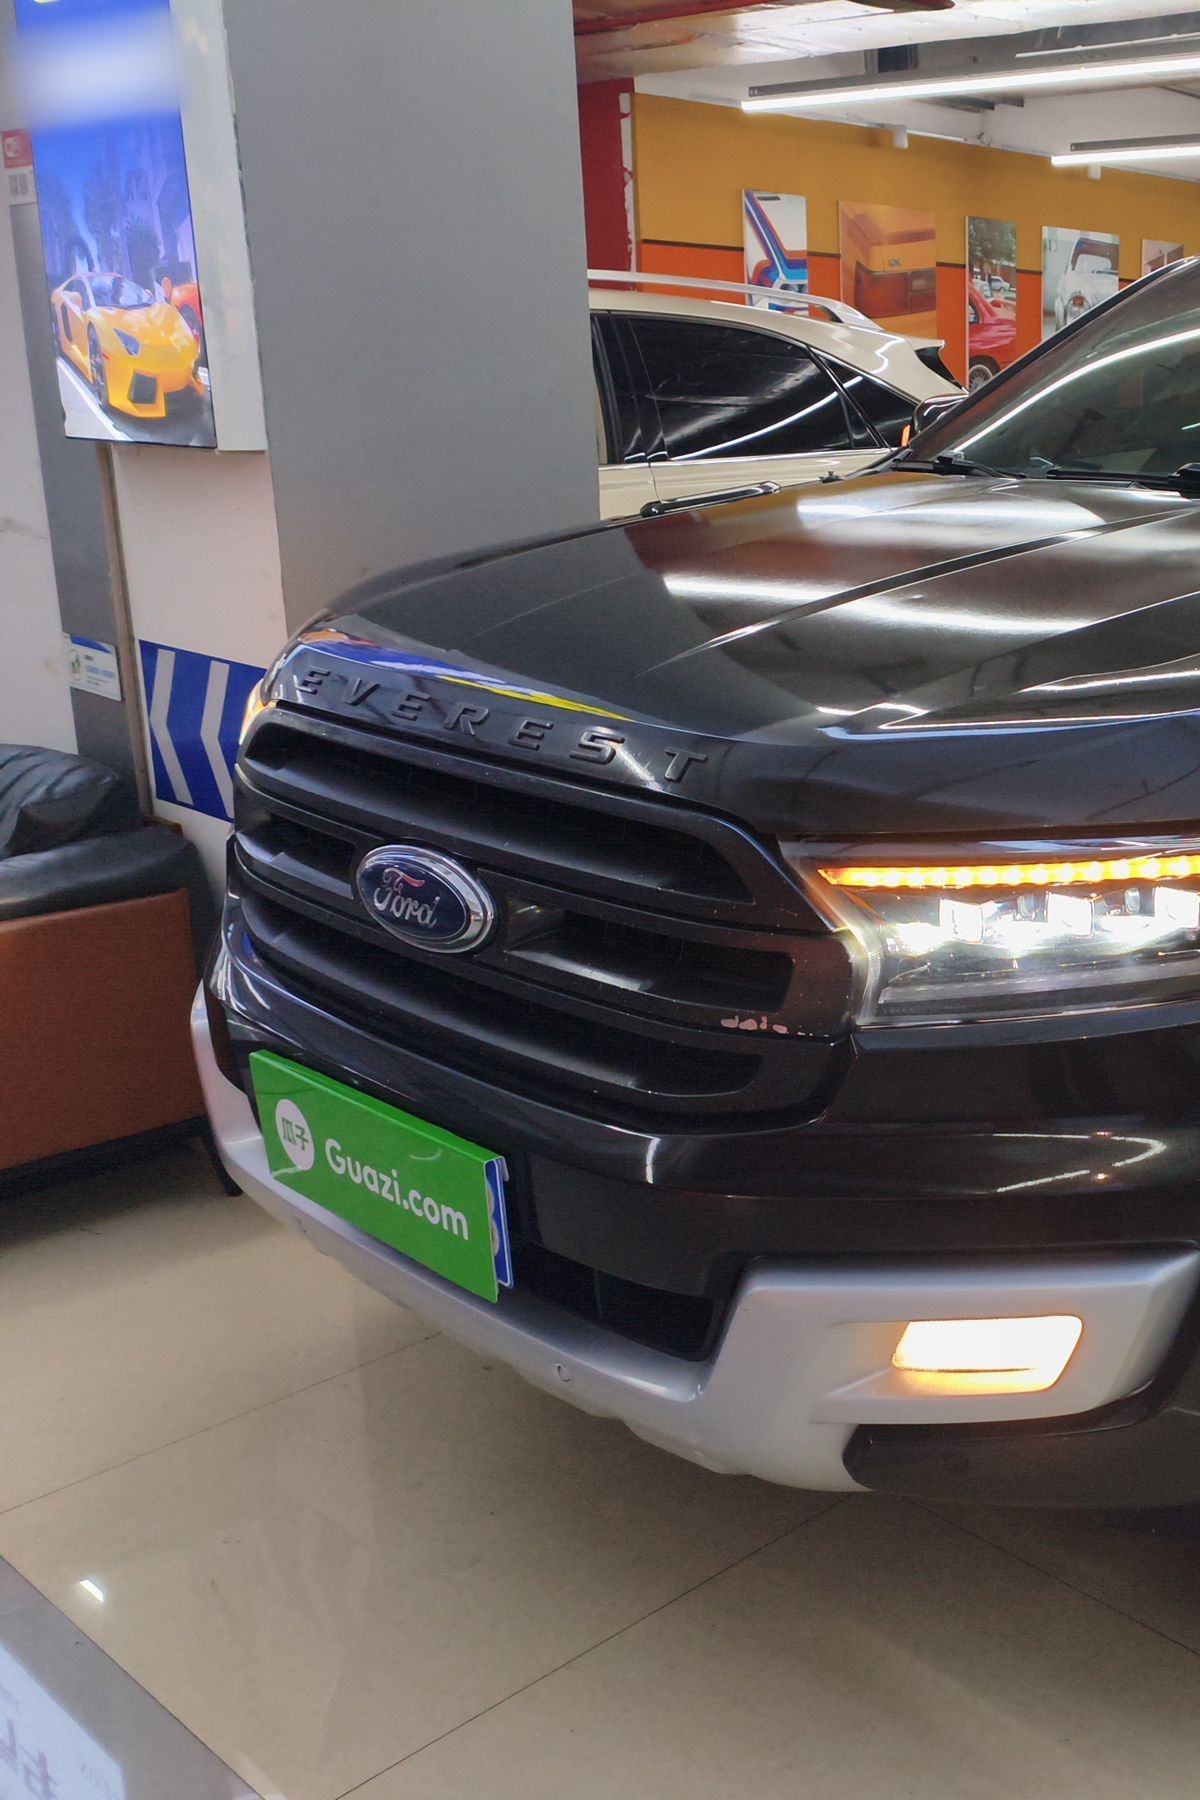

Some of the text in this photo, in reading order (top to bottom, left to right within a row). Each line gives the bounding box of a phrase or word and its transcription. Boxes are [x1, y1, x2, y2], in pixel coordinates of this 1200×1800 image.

[299, 666, 709, 783] EVEREST
[373, 867, 440, 929] Ford
[281, 1117, 309, 1151] 瓜子
[325, 1138, 469, 1240] Guazi.com
